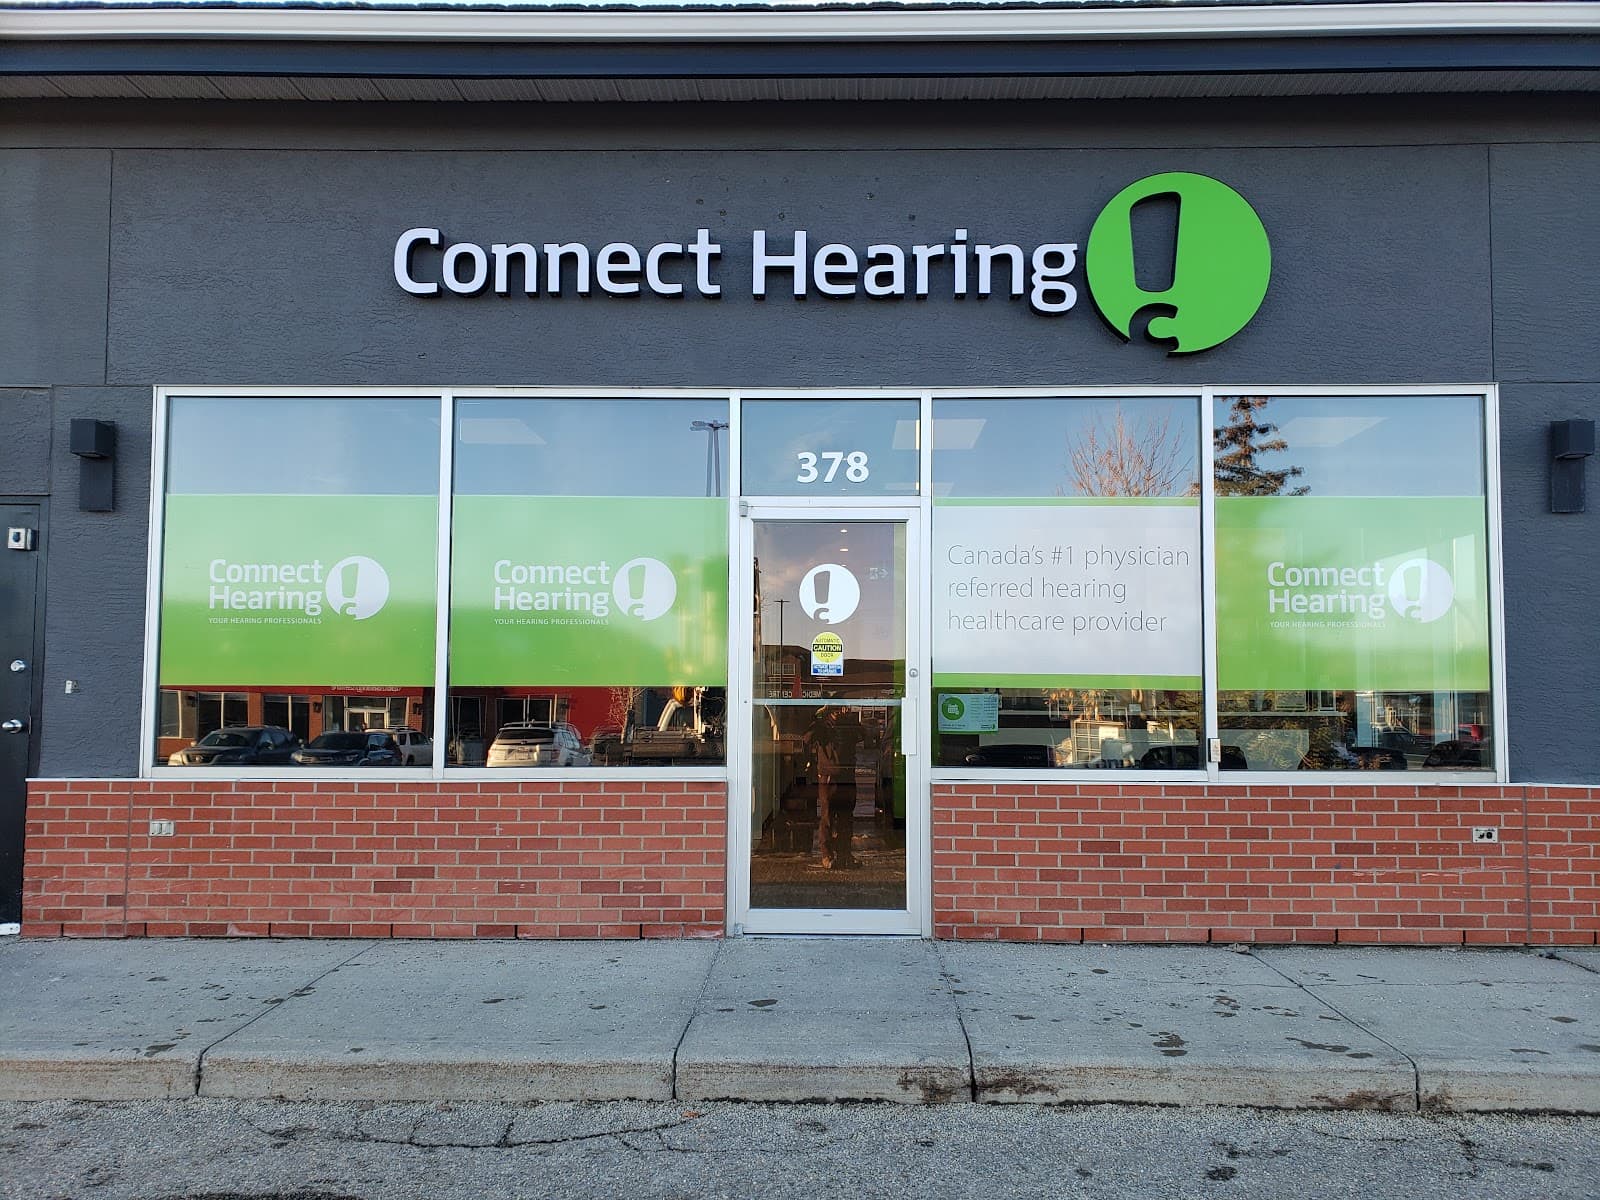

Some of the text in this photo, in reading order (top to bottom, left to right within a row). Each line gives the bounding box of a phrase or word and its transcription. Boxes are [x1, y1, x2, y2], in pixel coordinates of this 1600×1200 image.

[393, 227, 1079, 315] Connect Hearing
[796, 451, 870, 483] 378
[947, 544, 1190, 571] Canada's #1 physician
[209, 559, 323, 584] Connect
[494, 559, 610, 585] Connect
[1267, 561, 1385, 587] Connect
[209, 585, 323, 616] Hearing
[494, 587, 610, 617] Hearing
[948, 577, 1127, 604] referred hearing
[1268, 588, 1386, 620] Hearing
[208, 617, 322, 625] YOUR HEARING PROFESSIONALS
[551, 618, 609, 626] PROFESSIONALS
[948, 609, 1168, 636] healthcare provider
[1292, 621, 1325, 629] HEARING
